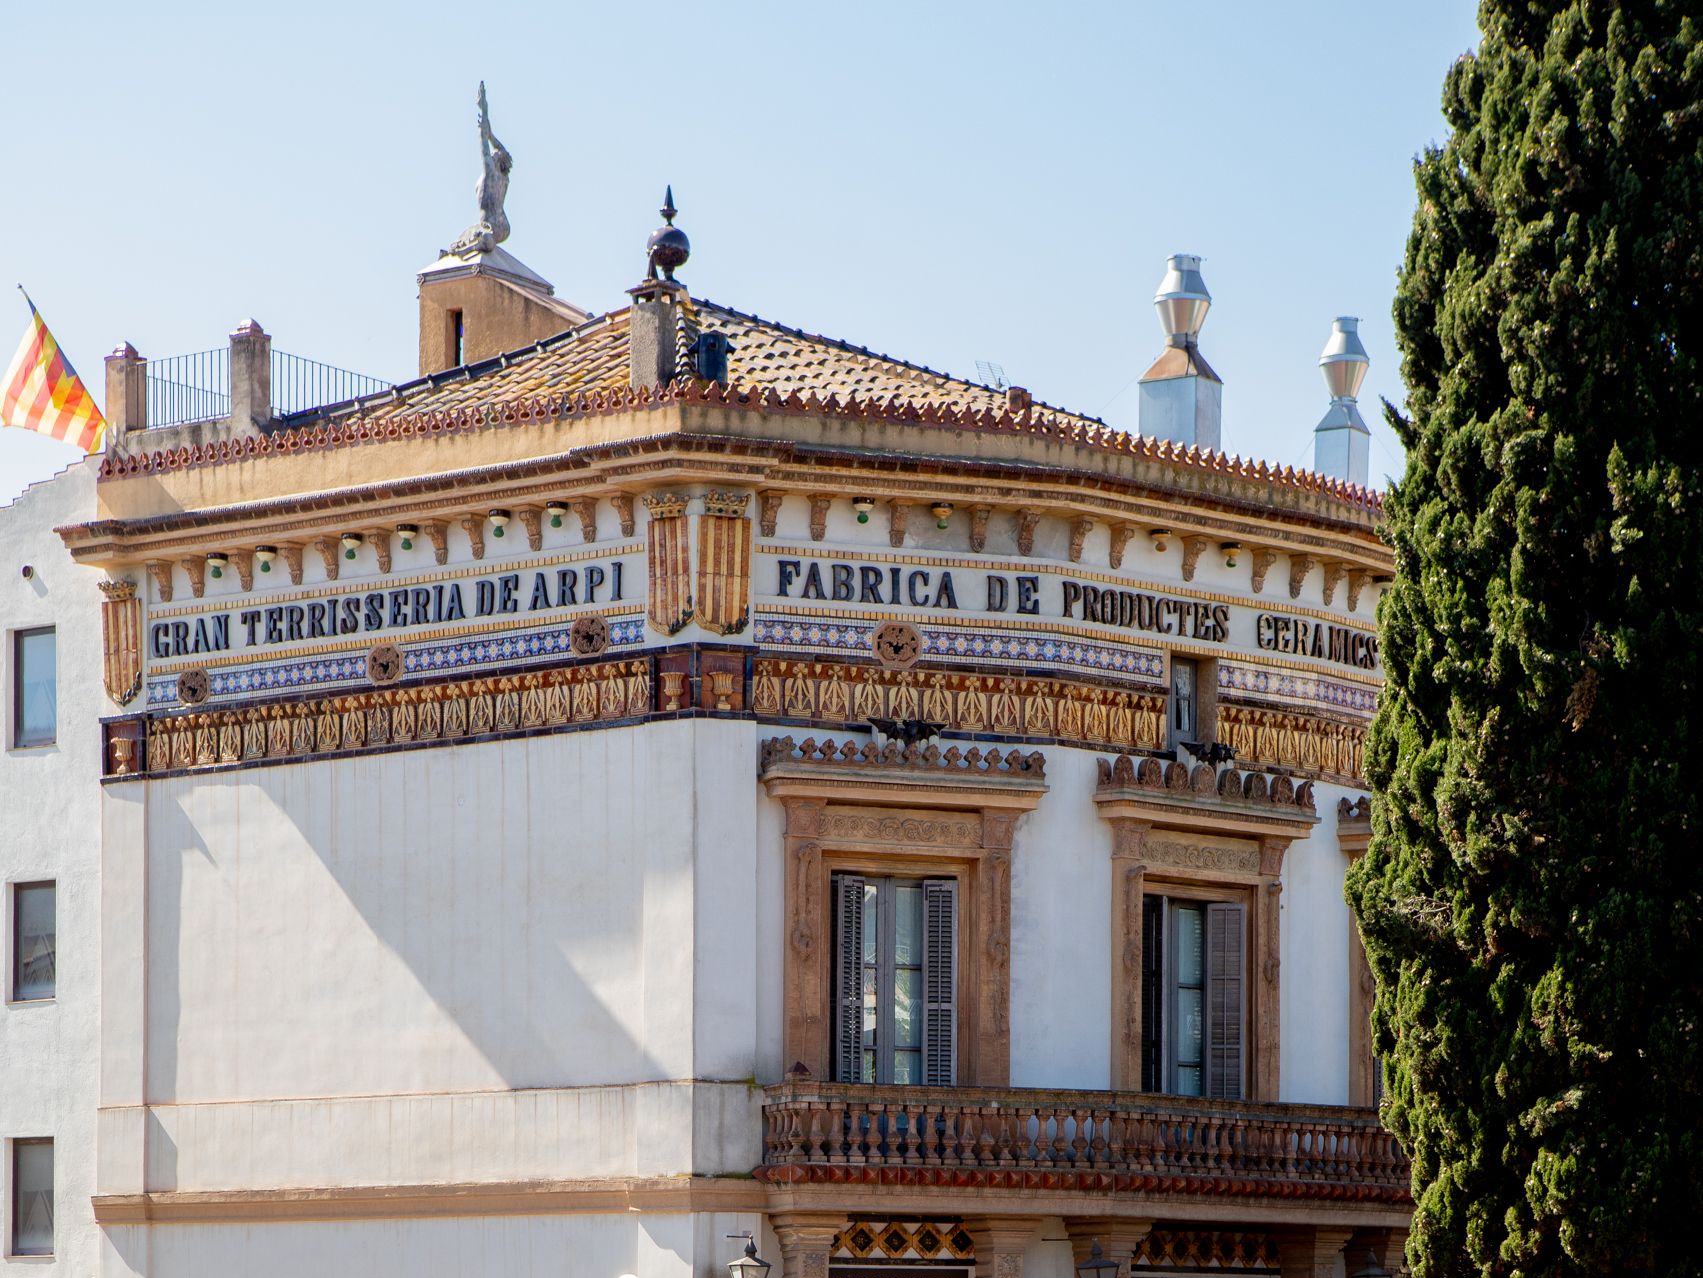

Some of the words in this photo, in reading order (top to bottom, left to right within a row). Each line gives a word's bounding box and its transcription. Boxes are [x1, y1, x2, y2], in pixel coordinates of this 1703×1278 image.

[151, 614, 230, 658] GRAN
[241, 583, 466, 647] TERRISSERIA
[475, 573, 520, 617] DE
[528, 561, 623, 611] ARPI
[777, 560, 959, 610] FABRICA
[986, 575, 1040, 615] DE
[1062, 580, 1230, 643] PRODUCTES
[1257, 612, 1379, 671] CERAMICS
